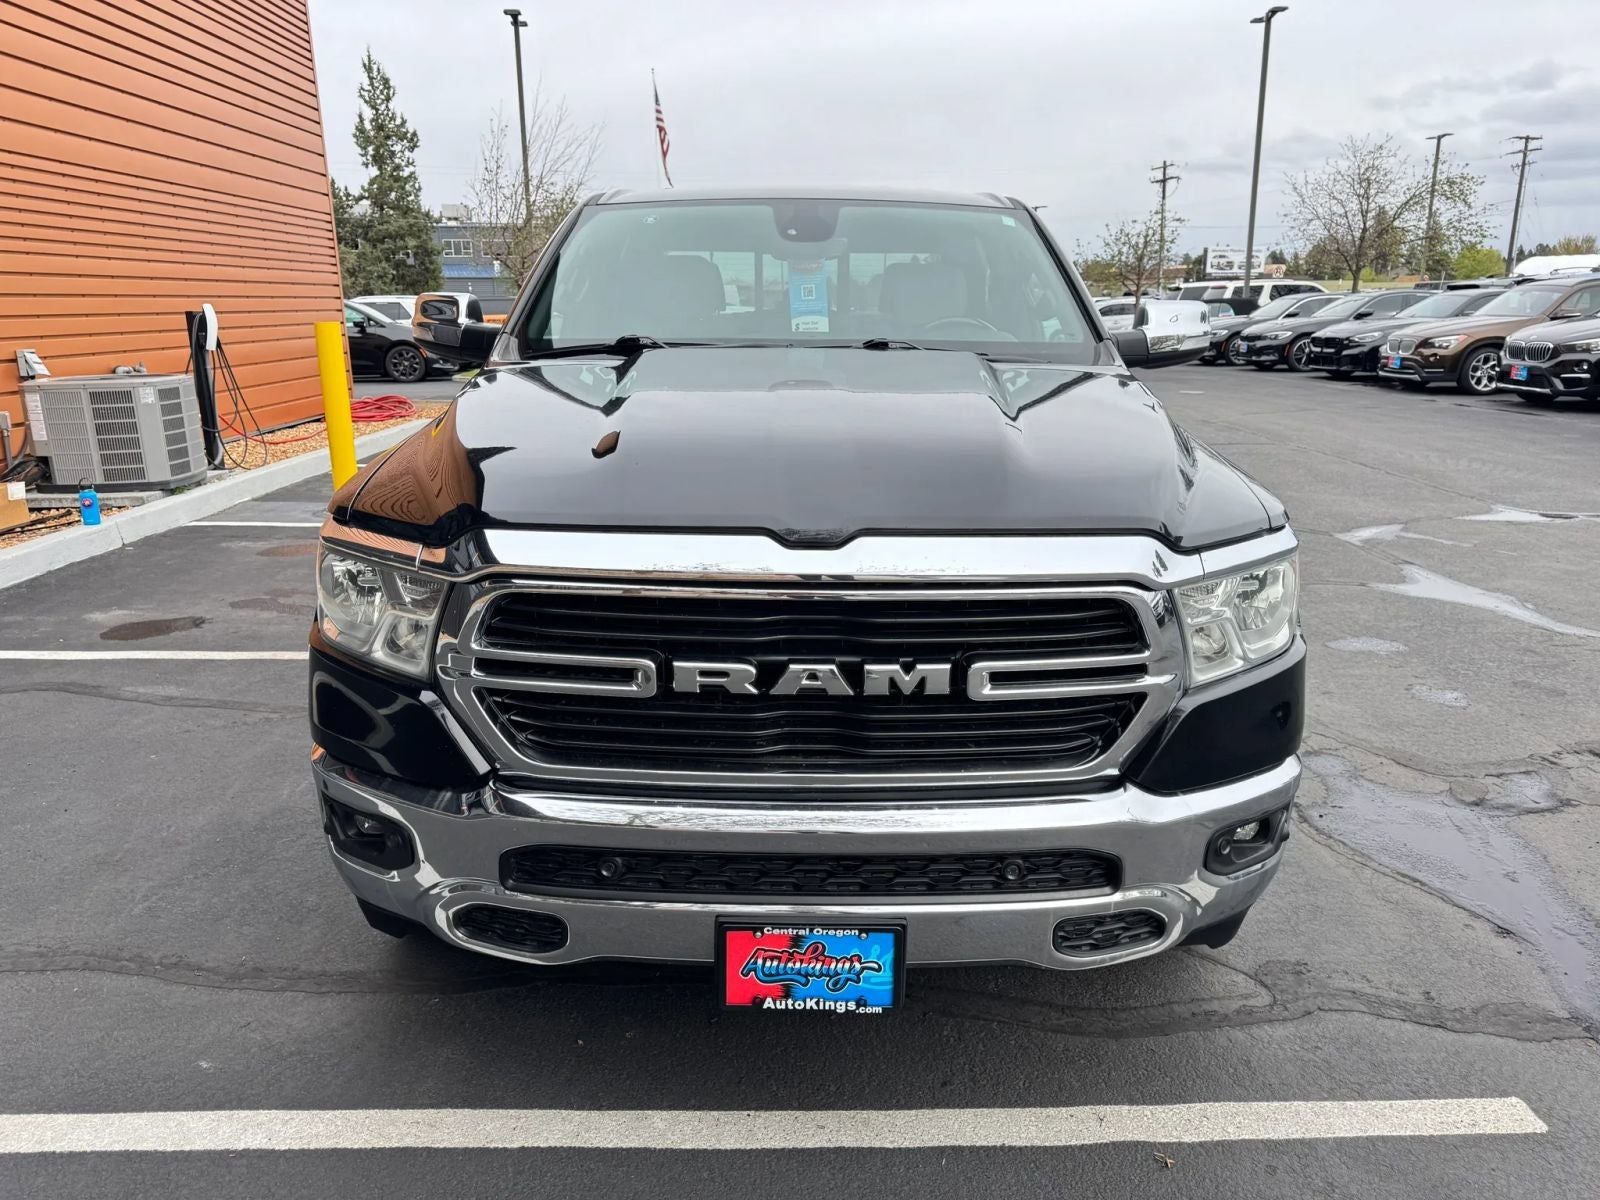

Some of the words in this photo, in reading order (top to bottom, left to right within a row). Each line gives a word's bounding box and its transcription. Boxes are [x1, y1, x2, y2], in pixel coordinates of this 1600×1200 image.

[672, 661, 952, 695] RAM
[763, 927, 808, 936] Central
[812, 928, 859, 938] Oregon
[763, 998, 882, 1014] AutoKings.com
